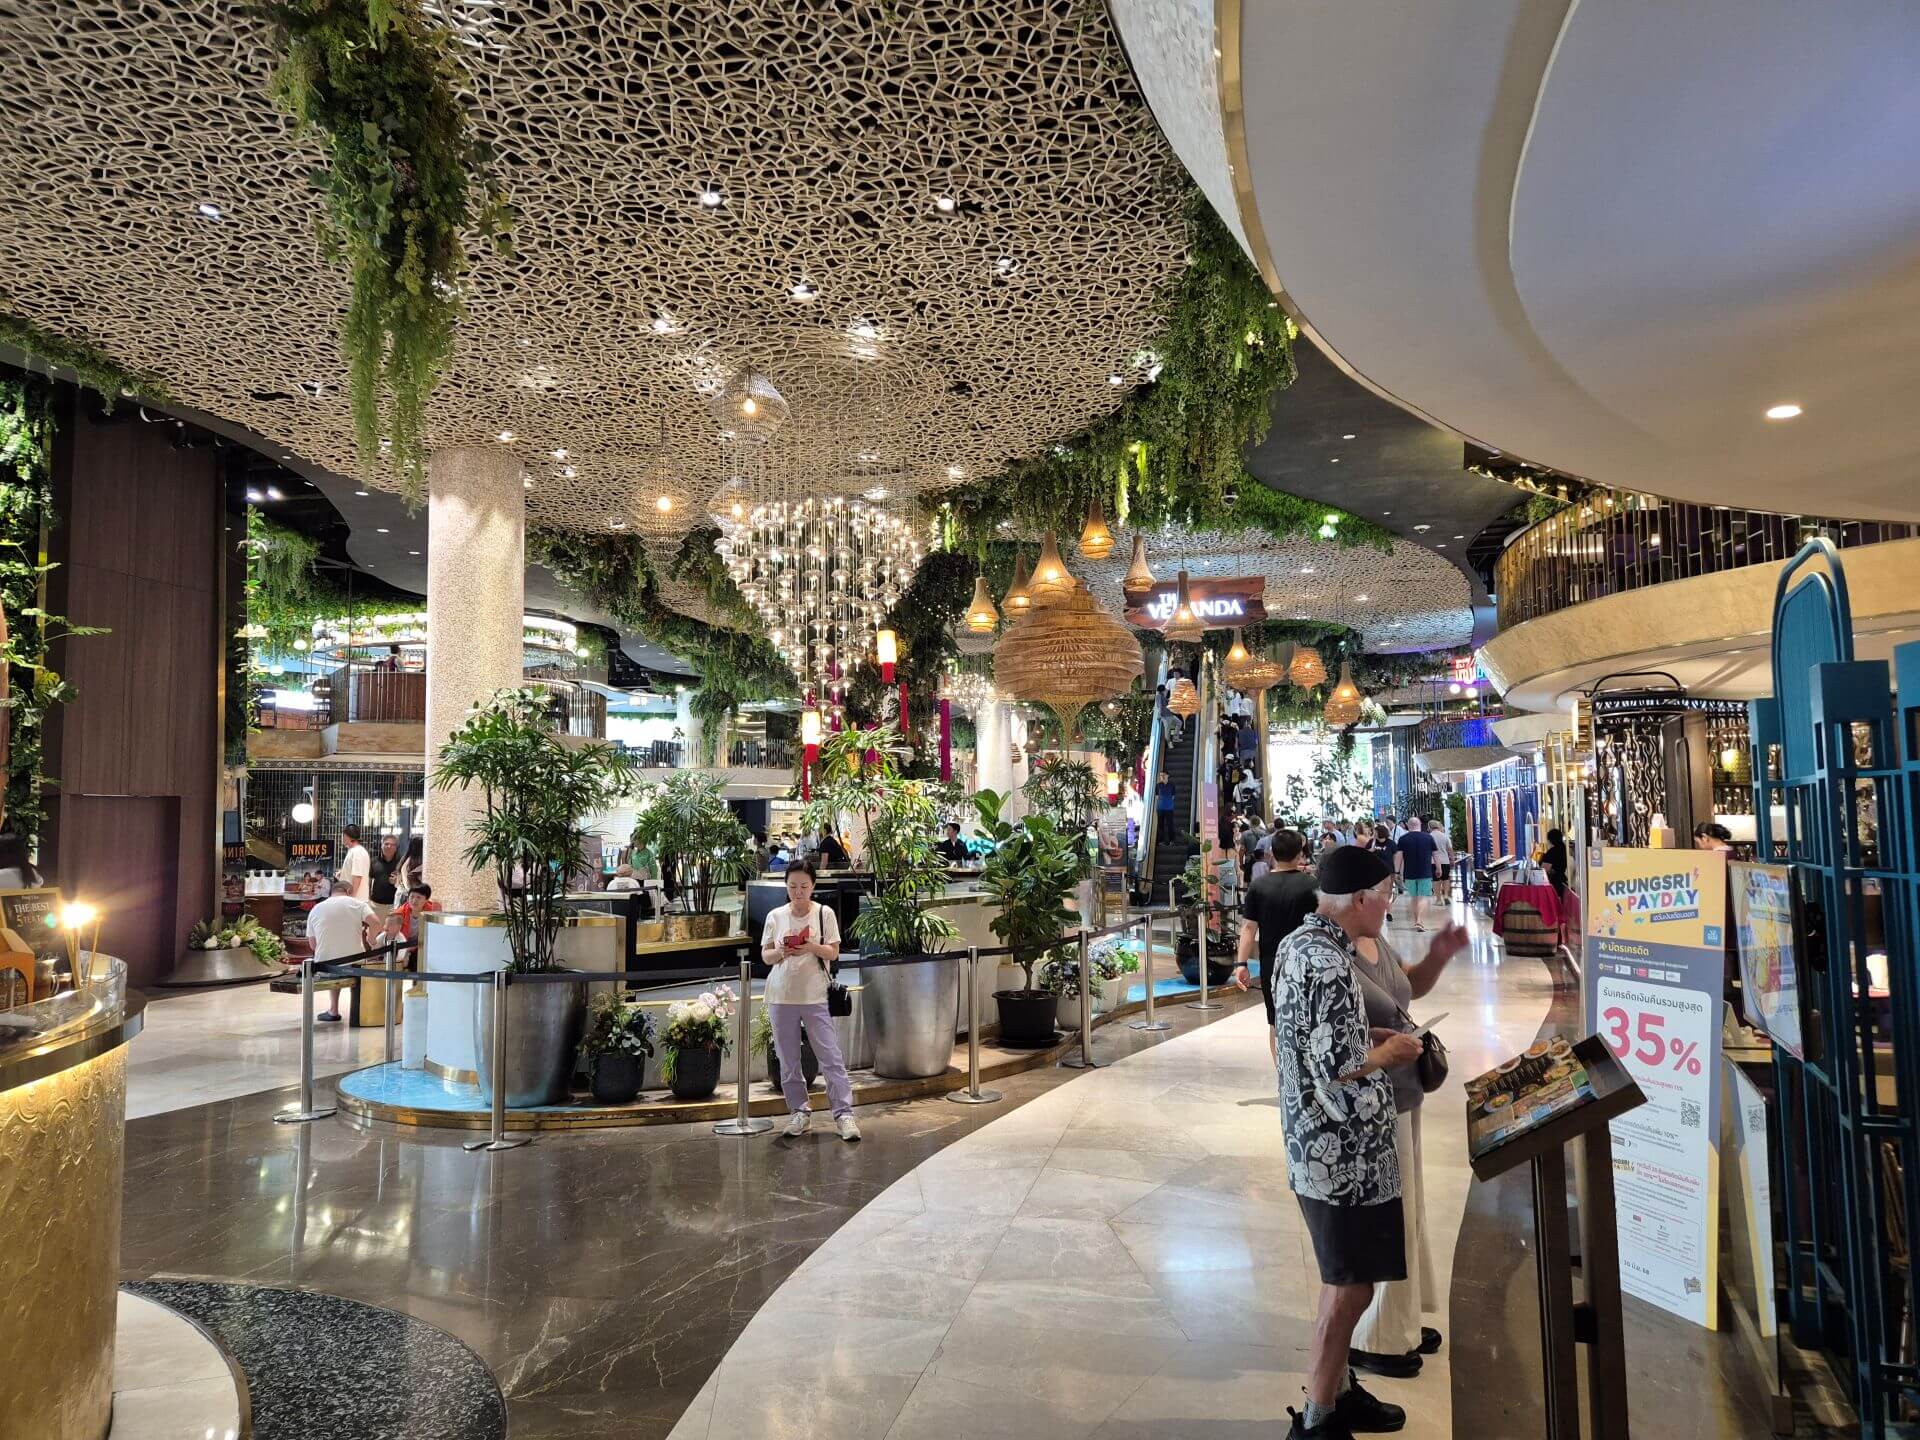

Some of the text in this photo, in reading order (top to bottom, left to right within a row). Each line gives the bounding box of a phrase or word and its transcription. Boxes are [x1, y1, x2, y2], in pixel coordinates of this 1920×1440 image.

[292, 844, 327, 856] DRINKS
[1604, 872, 1690, 896] KRUNGSRI
[1627, 889, 1698, 911] PAYDAY
[1608, 942, 1649, 957] บัตรเครดิต
[1603, 987, 1703, 1014] รับเครดิตเงินคืนรวมสูงสุด
[1602, 1006, 1702, 1077] 35%
